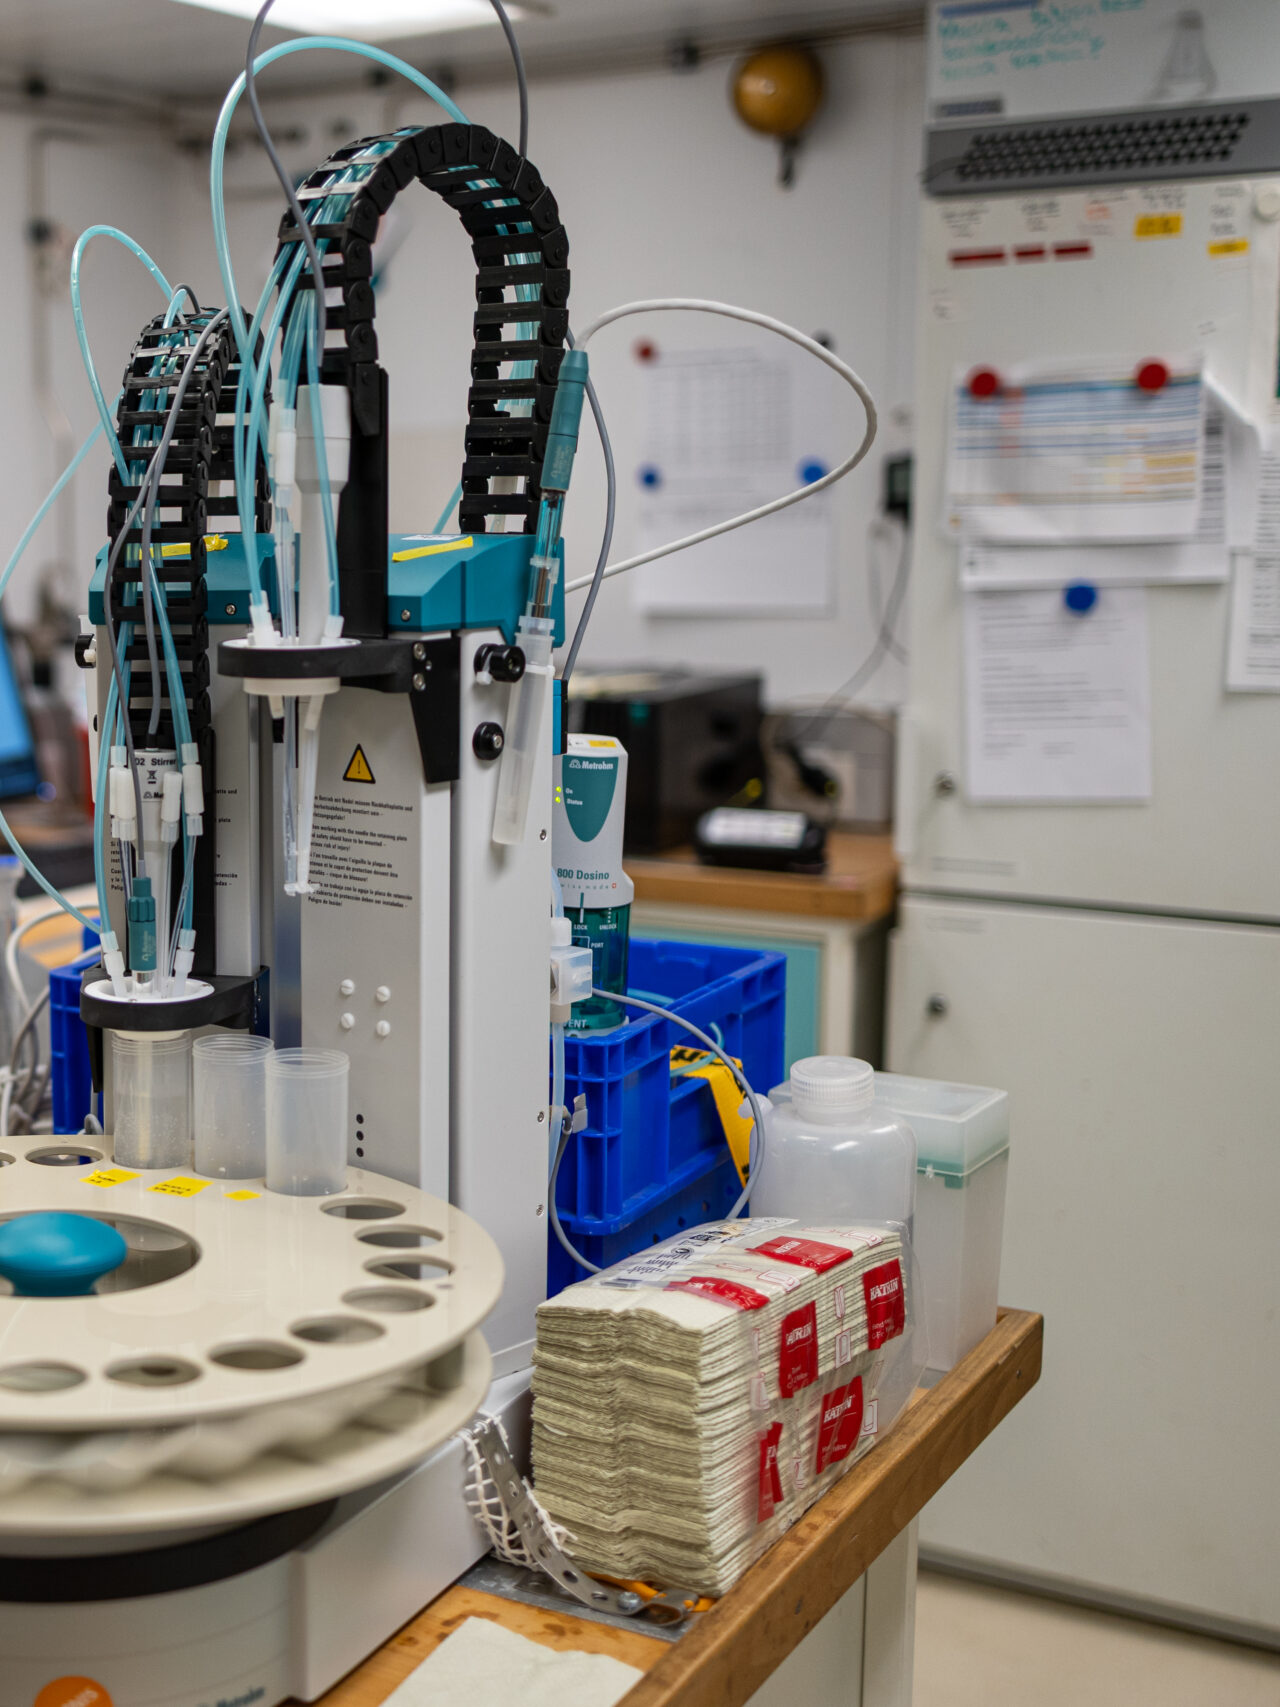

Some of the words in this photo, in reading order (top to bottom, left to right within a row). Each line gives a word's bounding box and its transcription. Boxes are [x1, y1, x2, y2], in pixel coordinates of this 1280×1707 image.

[136, 758, 145, 766] 02
[151, 758, 177, 766] Stirrer
[582, 761, 613, 770] Metrohm
[557, 868, 574, 879] 800
[576, 870, 609, 880] Dosino
[870, 1276, 899, 1301] KATRIN
